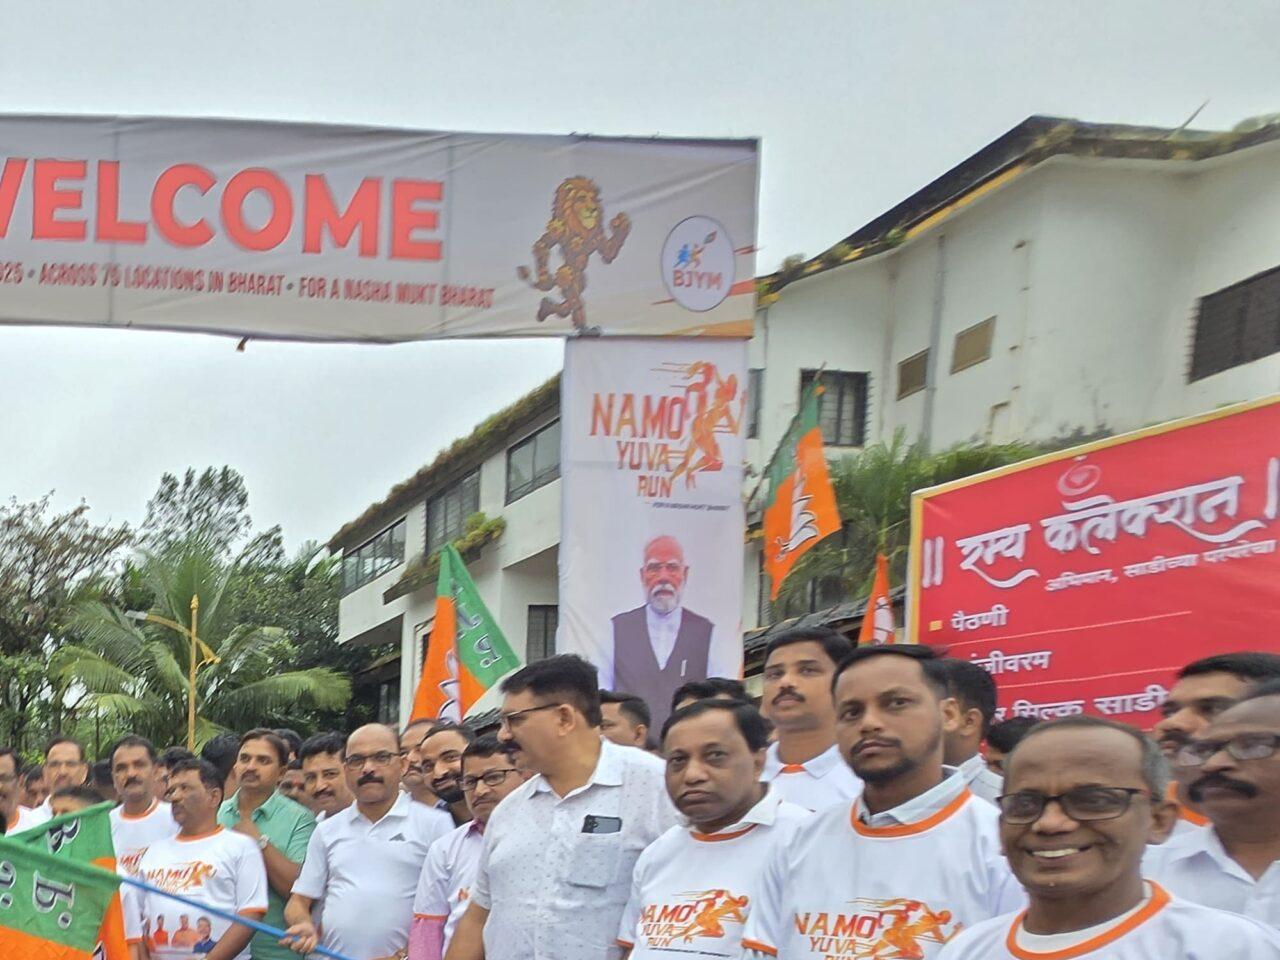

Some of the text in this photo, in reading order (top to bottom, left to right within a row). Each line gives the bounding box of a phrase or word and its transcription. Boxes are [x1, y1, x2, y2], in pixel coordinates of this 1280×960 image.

[38, 261, 98, 287] ACROSS
[123, 264, 206, 292] LOCATIONS
[207, 271, 224, 292] IN
[226, 271, 285, 296] BHARAT
[298, 276, 327, 299] FOR
[330, 278, 341, 300] A
[439, 284, 495, 309] BHARAT
[672, 269, 723, 290] BJYM
[589, 393, 688, 440] NAMO
[616, 440, 673, 472] YUVA
[636, 475, 672, 498] RUN
[951, 602, 1011, 633] पैठणी
[793, 912, 877, 940] NAMO
[810, 936, 857, 955] YUVA
